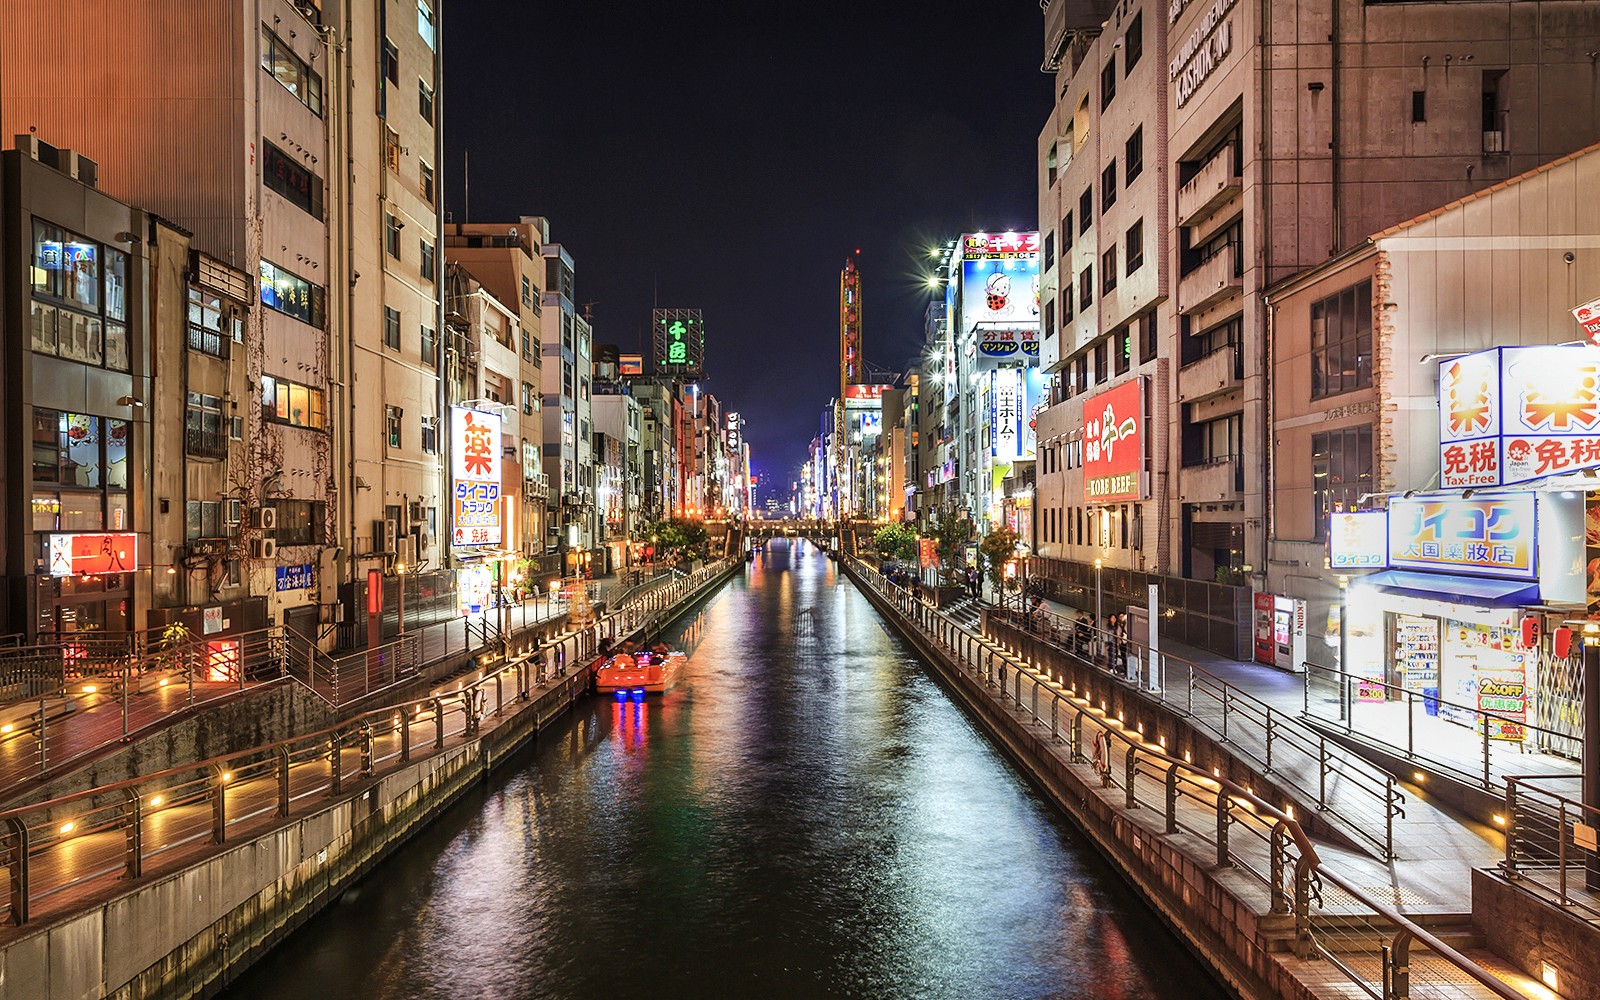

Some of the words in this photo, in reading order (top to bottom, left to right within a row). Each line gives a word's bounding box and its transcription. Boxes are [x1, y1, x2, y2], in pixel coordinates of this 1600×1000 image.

[669, 321, 686, 358] 千房
[983, 331, 1015, 341] 分譲
[1021, 331, 1039, 341] 賃
[982, 343, 1017, 351] マンション
[1444, 441, 1496, 476] 免税
[1535, 439, 1600, 475] 免税
[1090, 478, 1110, 495] KOBE
[1111, 475, 1131, 493] BEEF
[1445, 474, 1495, 486] Tax-Free
[457, 483, 499, 500] ダイコク
[1480, 678, 1523, 698] 2%OFF
[1501, 725, 1523, 735] NO.1
